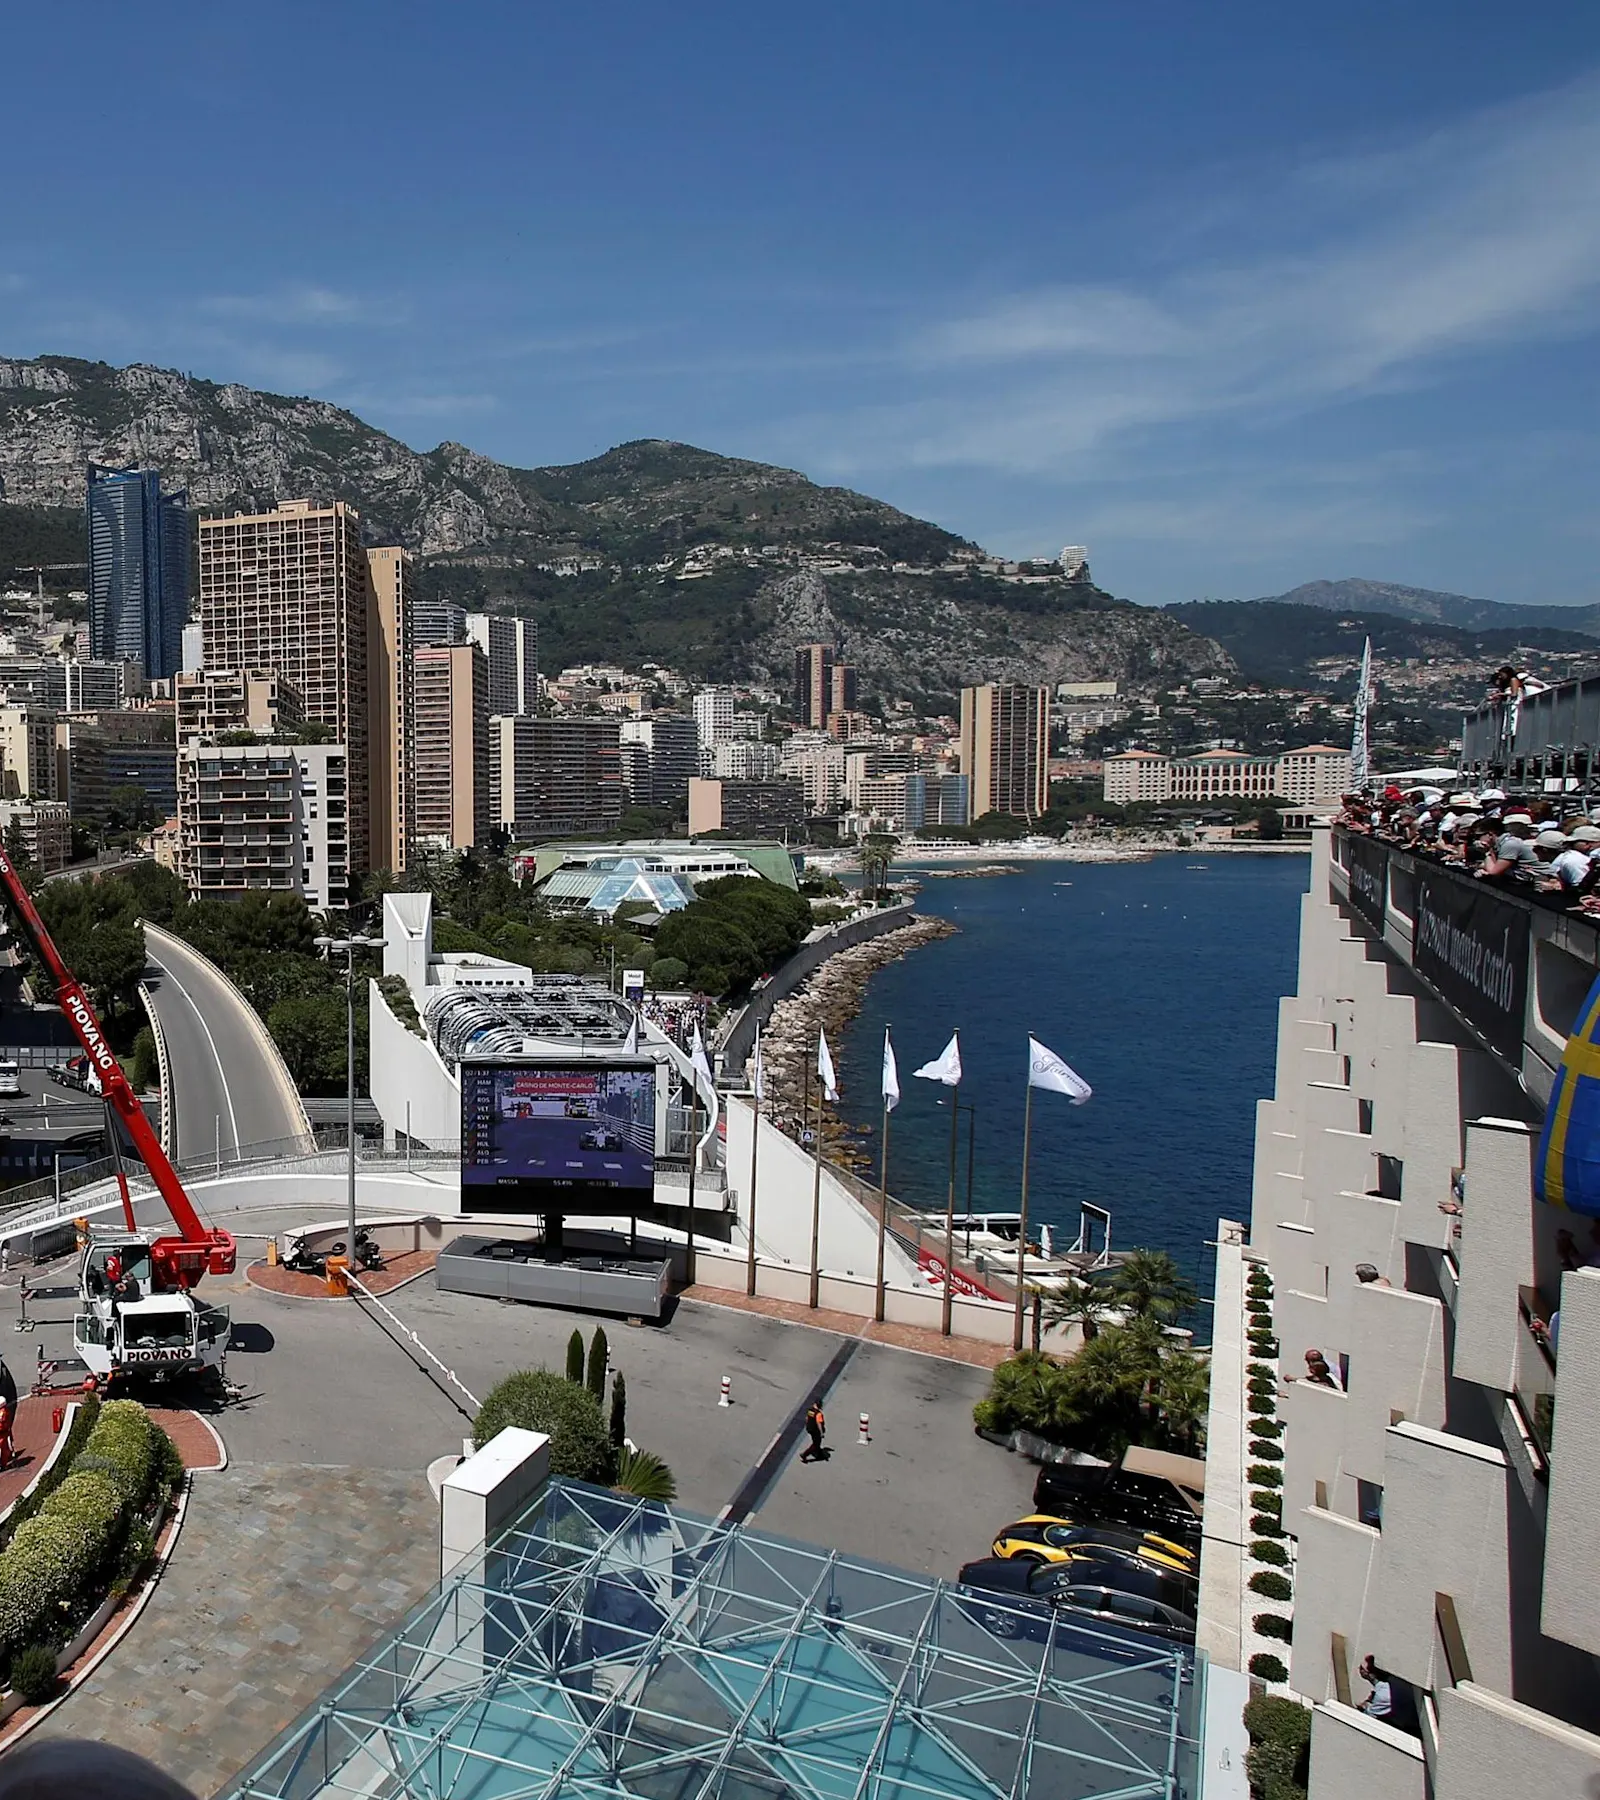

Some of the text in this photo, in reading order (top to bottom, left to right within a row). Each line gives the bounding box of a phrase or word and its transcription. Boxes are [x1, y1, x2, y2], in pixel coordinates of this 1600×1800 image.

[1482, 926, 1513, 1013] carlo
[65, 995, 113, 1070] PIOVANO
[127, 1349, 192, 1362] PIOVANO
